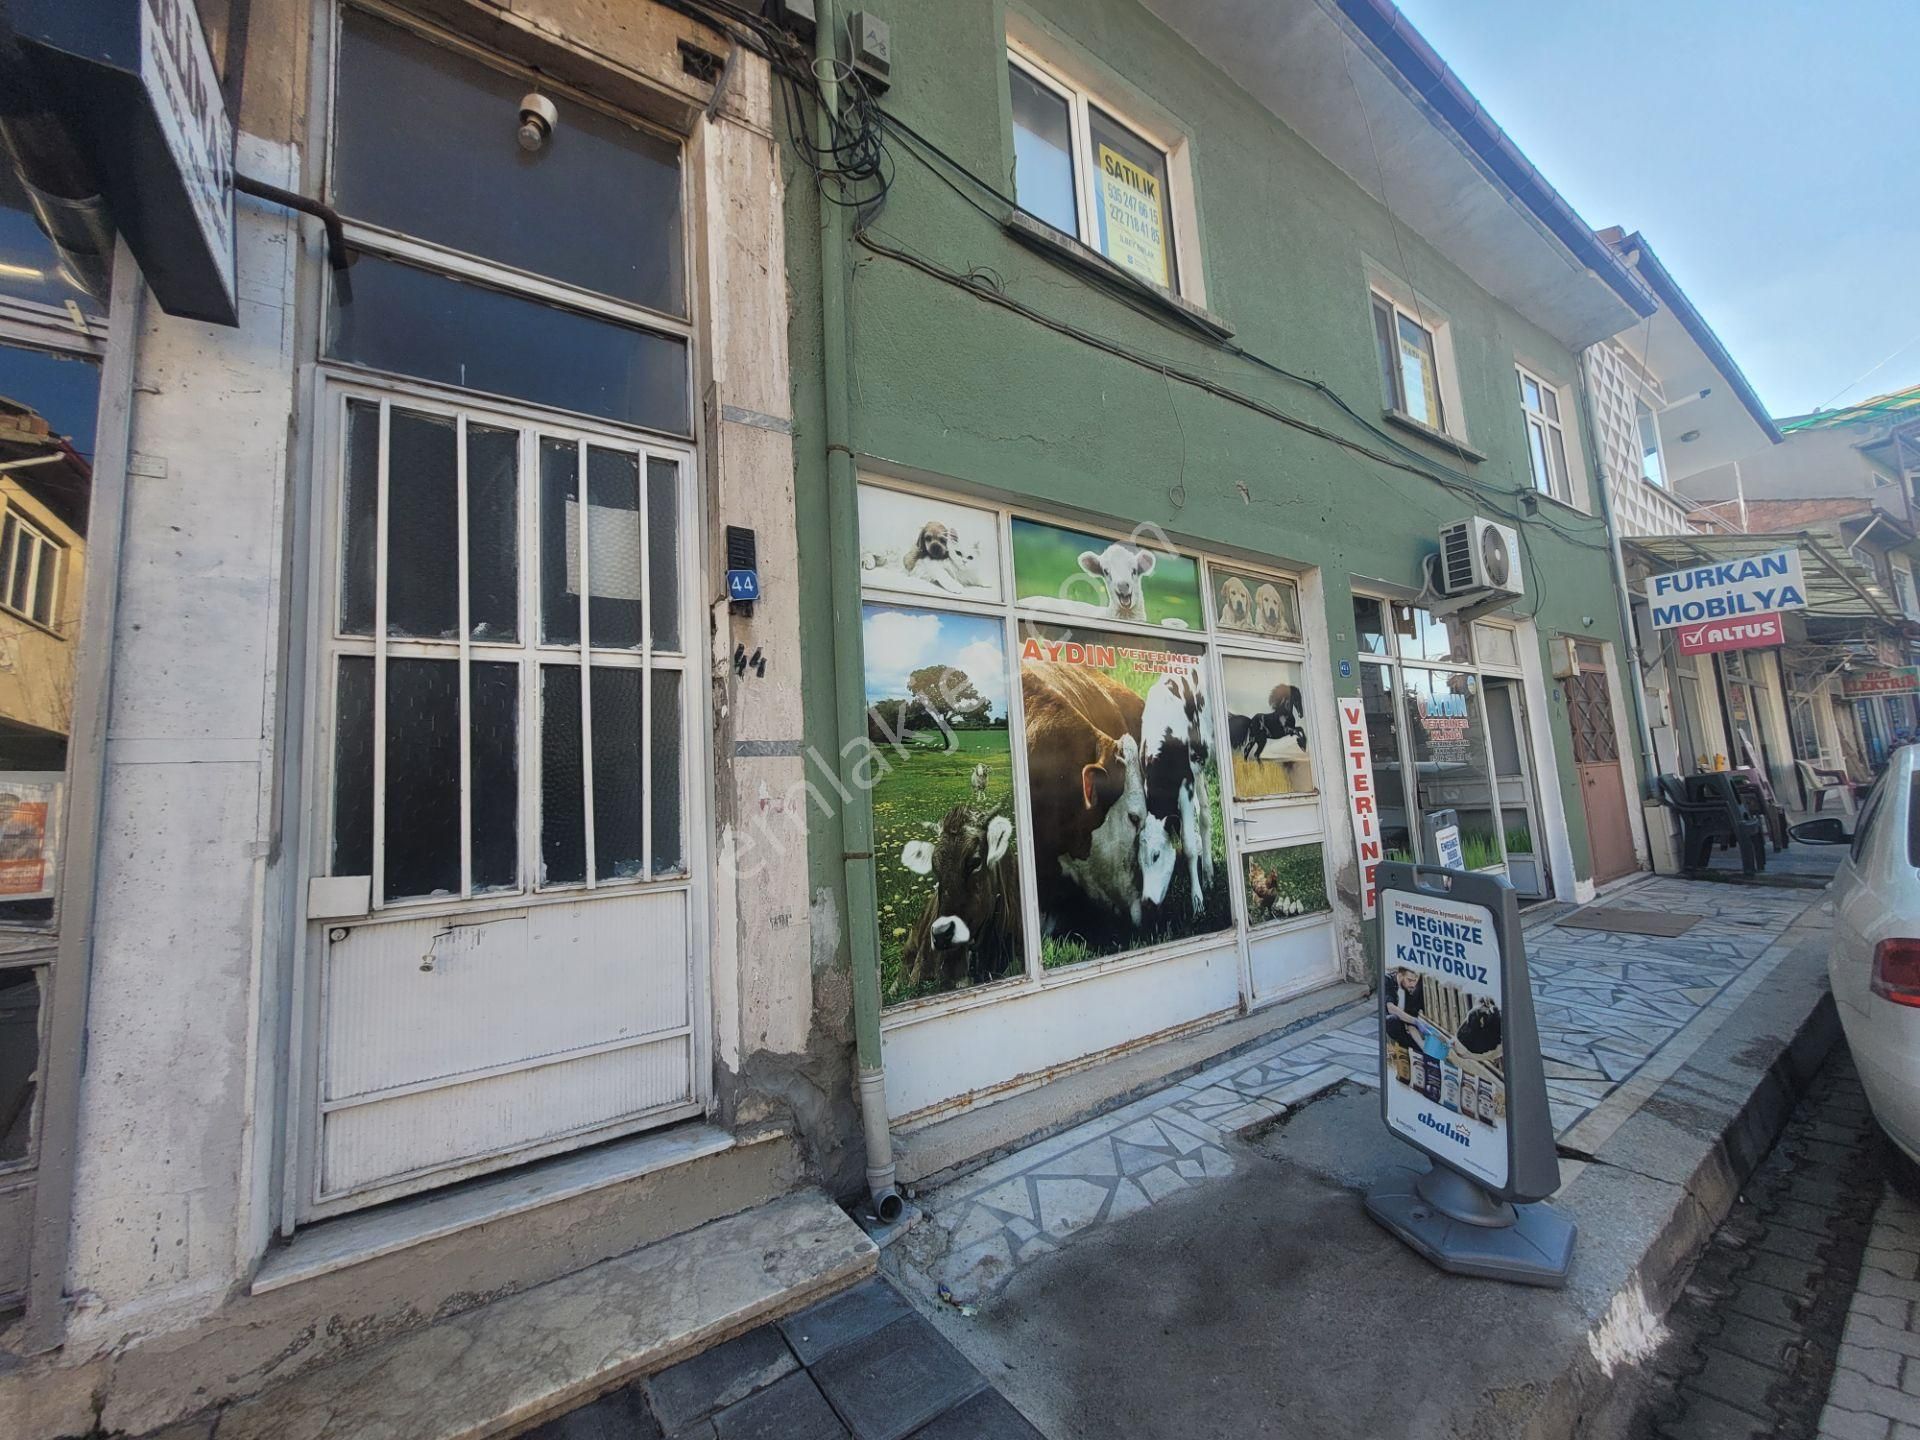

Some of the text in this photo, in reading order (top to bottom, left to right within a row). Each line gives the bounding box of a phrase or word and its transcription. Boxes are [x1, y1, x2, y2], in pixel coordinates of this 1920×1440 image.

[1104, 155, 1155, 200] SATILIK
[731, 576, 754, 592] 44
[1655, 554, 1788, 596] FURKAN
[1653, 585, 1805, 626] MOBİLYA
[1707, 621, 1776, 643] ALTUS
[734, 643, 768, 681] 44
[1021, 637, 1200, 669] AYDIN VETERİNER
[1395, 910, 1483, 945] EMEĞİNİZE
[1411, 931, 1466, 960] DEĞER
[1396, 944, 1488, 985] KATIYORUZ
